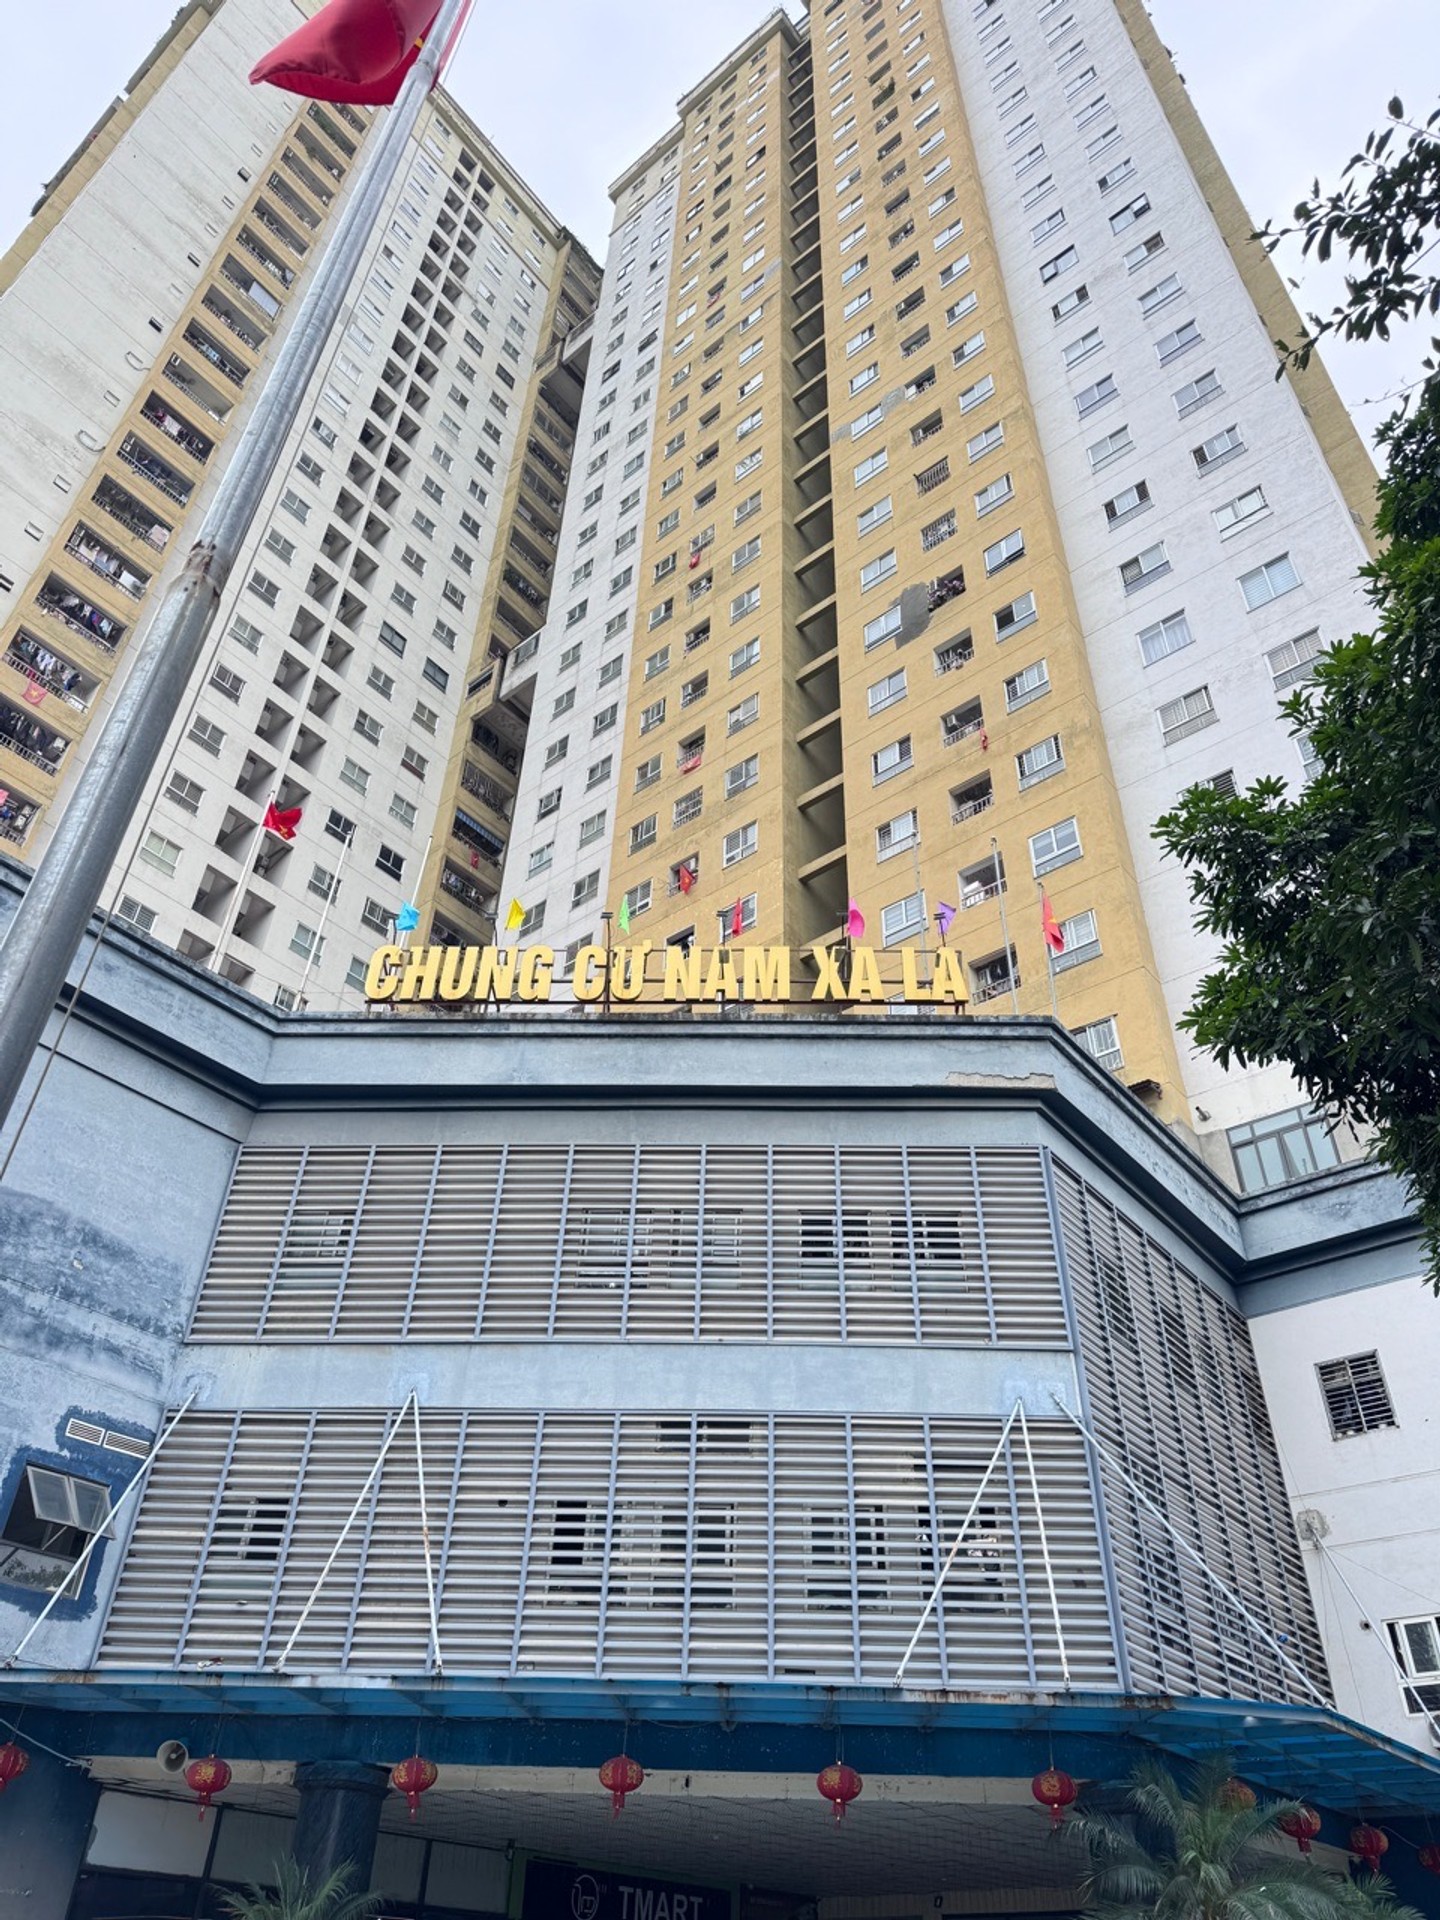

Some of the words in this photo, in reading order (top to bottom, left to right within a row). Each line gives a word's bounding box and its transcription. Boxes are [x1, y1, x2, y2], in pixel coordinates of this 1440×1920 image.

[364, 944, 555, 1001] CHUNG
[572, 939, 652, 1001] CƯ
[663, 945, 790, 1002] NAM
[811, 945, 884, 1002] XA
[901, 945, 969, 1002] LA
[618, 1885, 704, 1920] TMART
